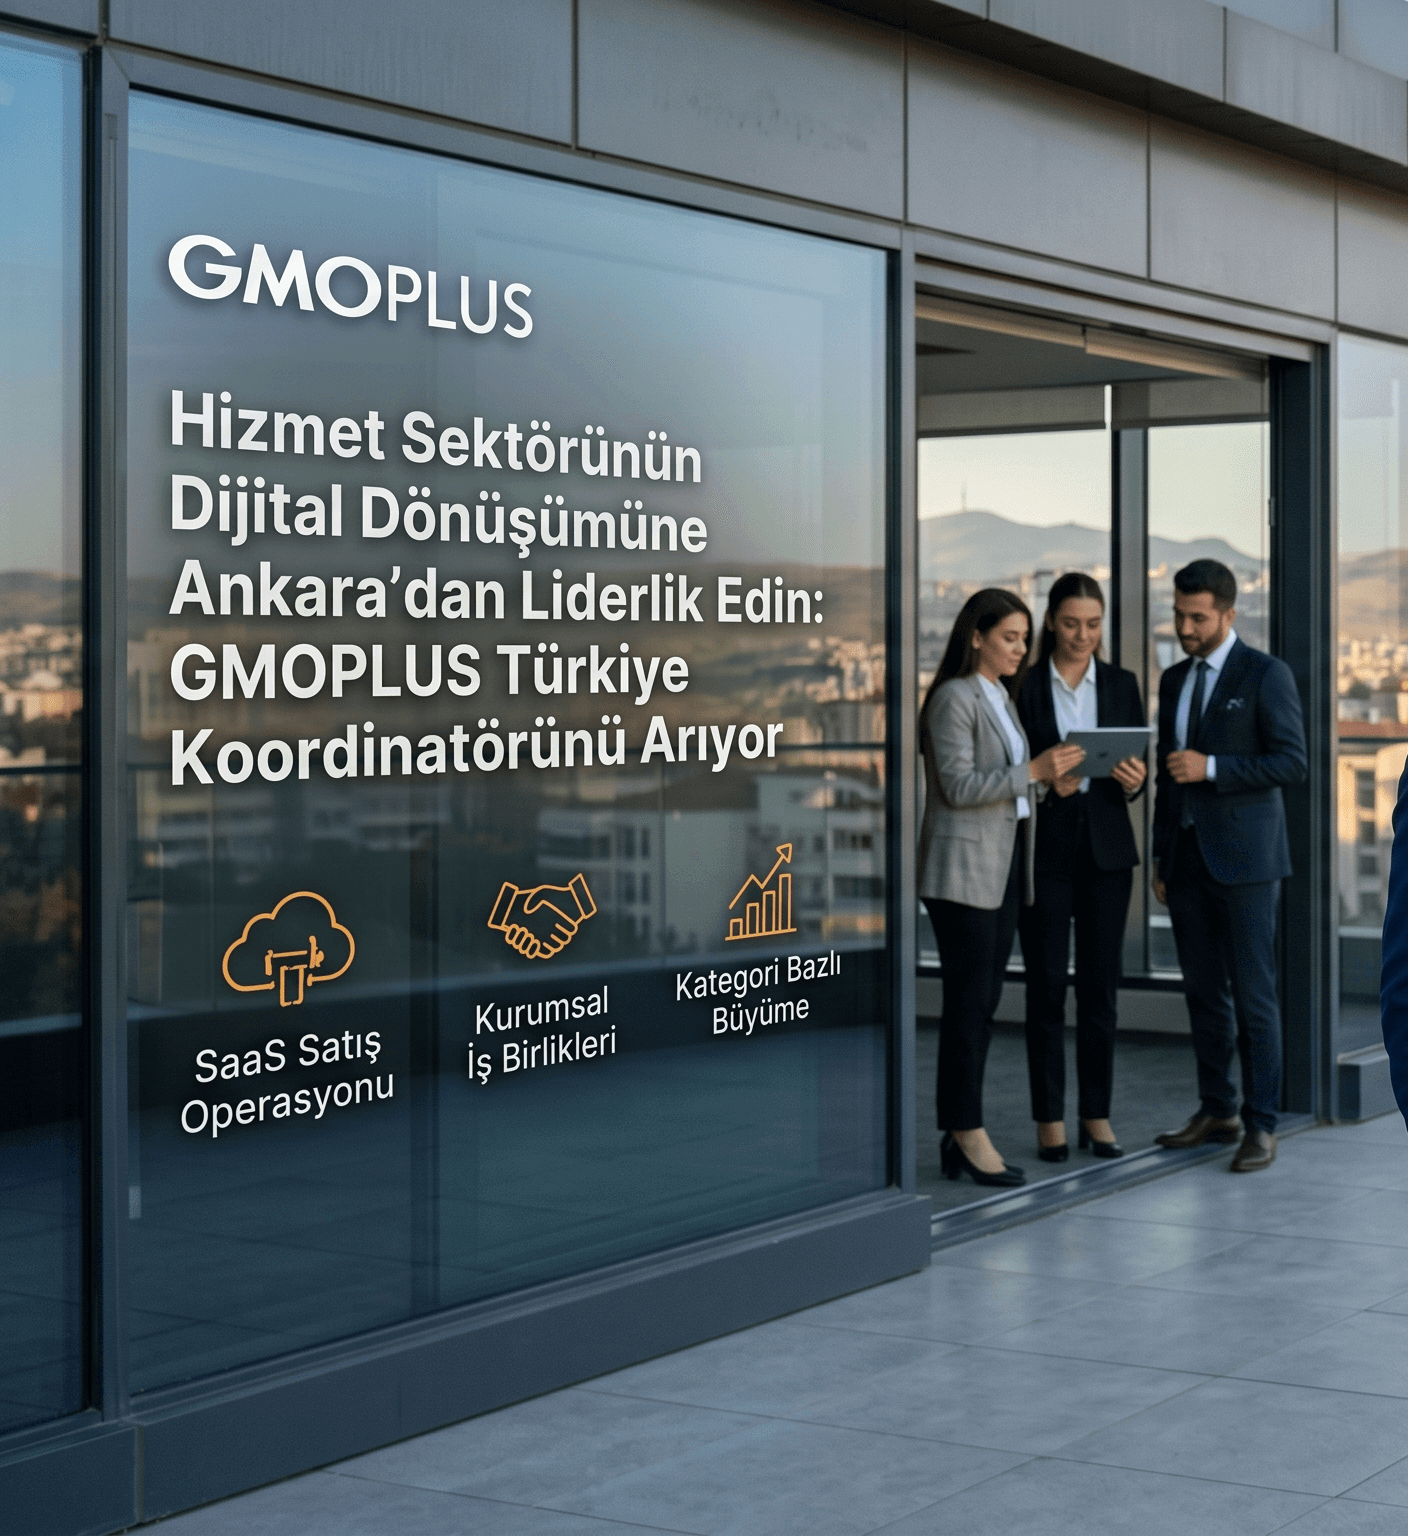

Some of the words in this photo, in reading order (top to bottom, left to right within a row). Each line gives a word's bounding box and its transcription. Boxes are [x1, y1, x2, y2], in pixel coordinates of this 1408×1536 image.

[168, 234, 532, 338] GMOPLUS
[171, 390, 385, 460] Hizmet
[402, 411, 701, 483] Sektörünün
[171, 475, 342, 546] Dijital
[362, 486, 708, 559] Dönüşümüne
[522, 569, 704, 622] Liderlik
[717, 576, 824, 624] Edin:
[170, 644, 481, 701] GMOPLUS
[498, 642, 689, 705] Türkiye
[171, 716, 626, 786] Koordinatörünü
[641, 716, 783, 772] Arıyor
[676, 958, 779, 1004] Kategori
[788, 951, 841, 986] Bazlı
[476, 986, 609, 1034] Kurumsal
[712, 996, 809, 1039] Büyüme
[195, 1041, 286, 1084] SaaS
[299, 1029, 382, 1068] Satış
[468, 1042, 491, 1085] İş
[502, 1026, 617, 1074] Birlikleri
[181, 1074, 394, 1139] Operasyonu
